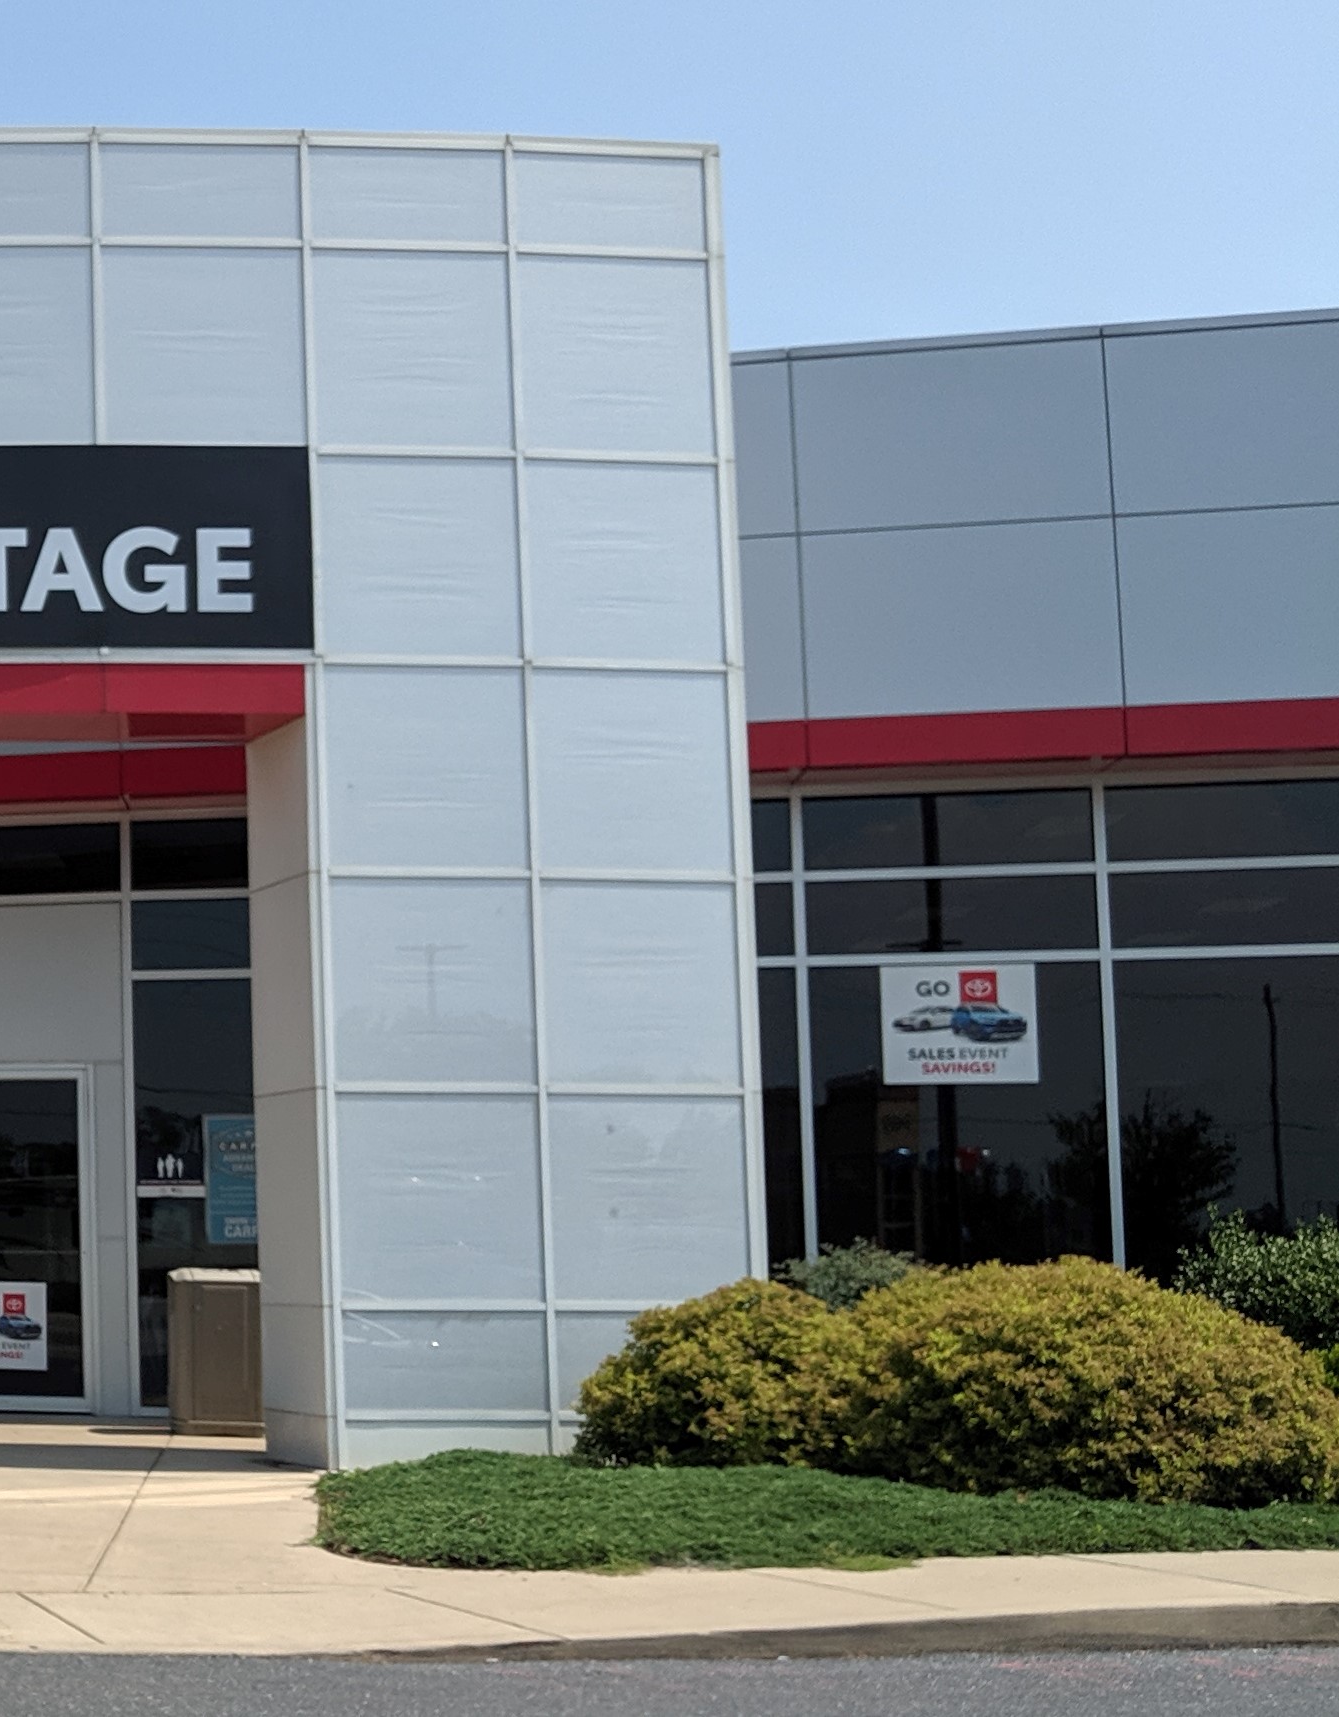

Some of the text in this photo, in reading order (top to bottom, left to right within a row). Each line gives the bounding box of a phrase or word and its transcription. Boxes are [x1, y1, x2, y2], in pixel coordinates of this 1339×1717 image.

[915, 980, 950, 997] GO
[907, 1046, 1009, 1061] SALES EVENT
[921, 1061, 996, 1075] SAVINGS!
